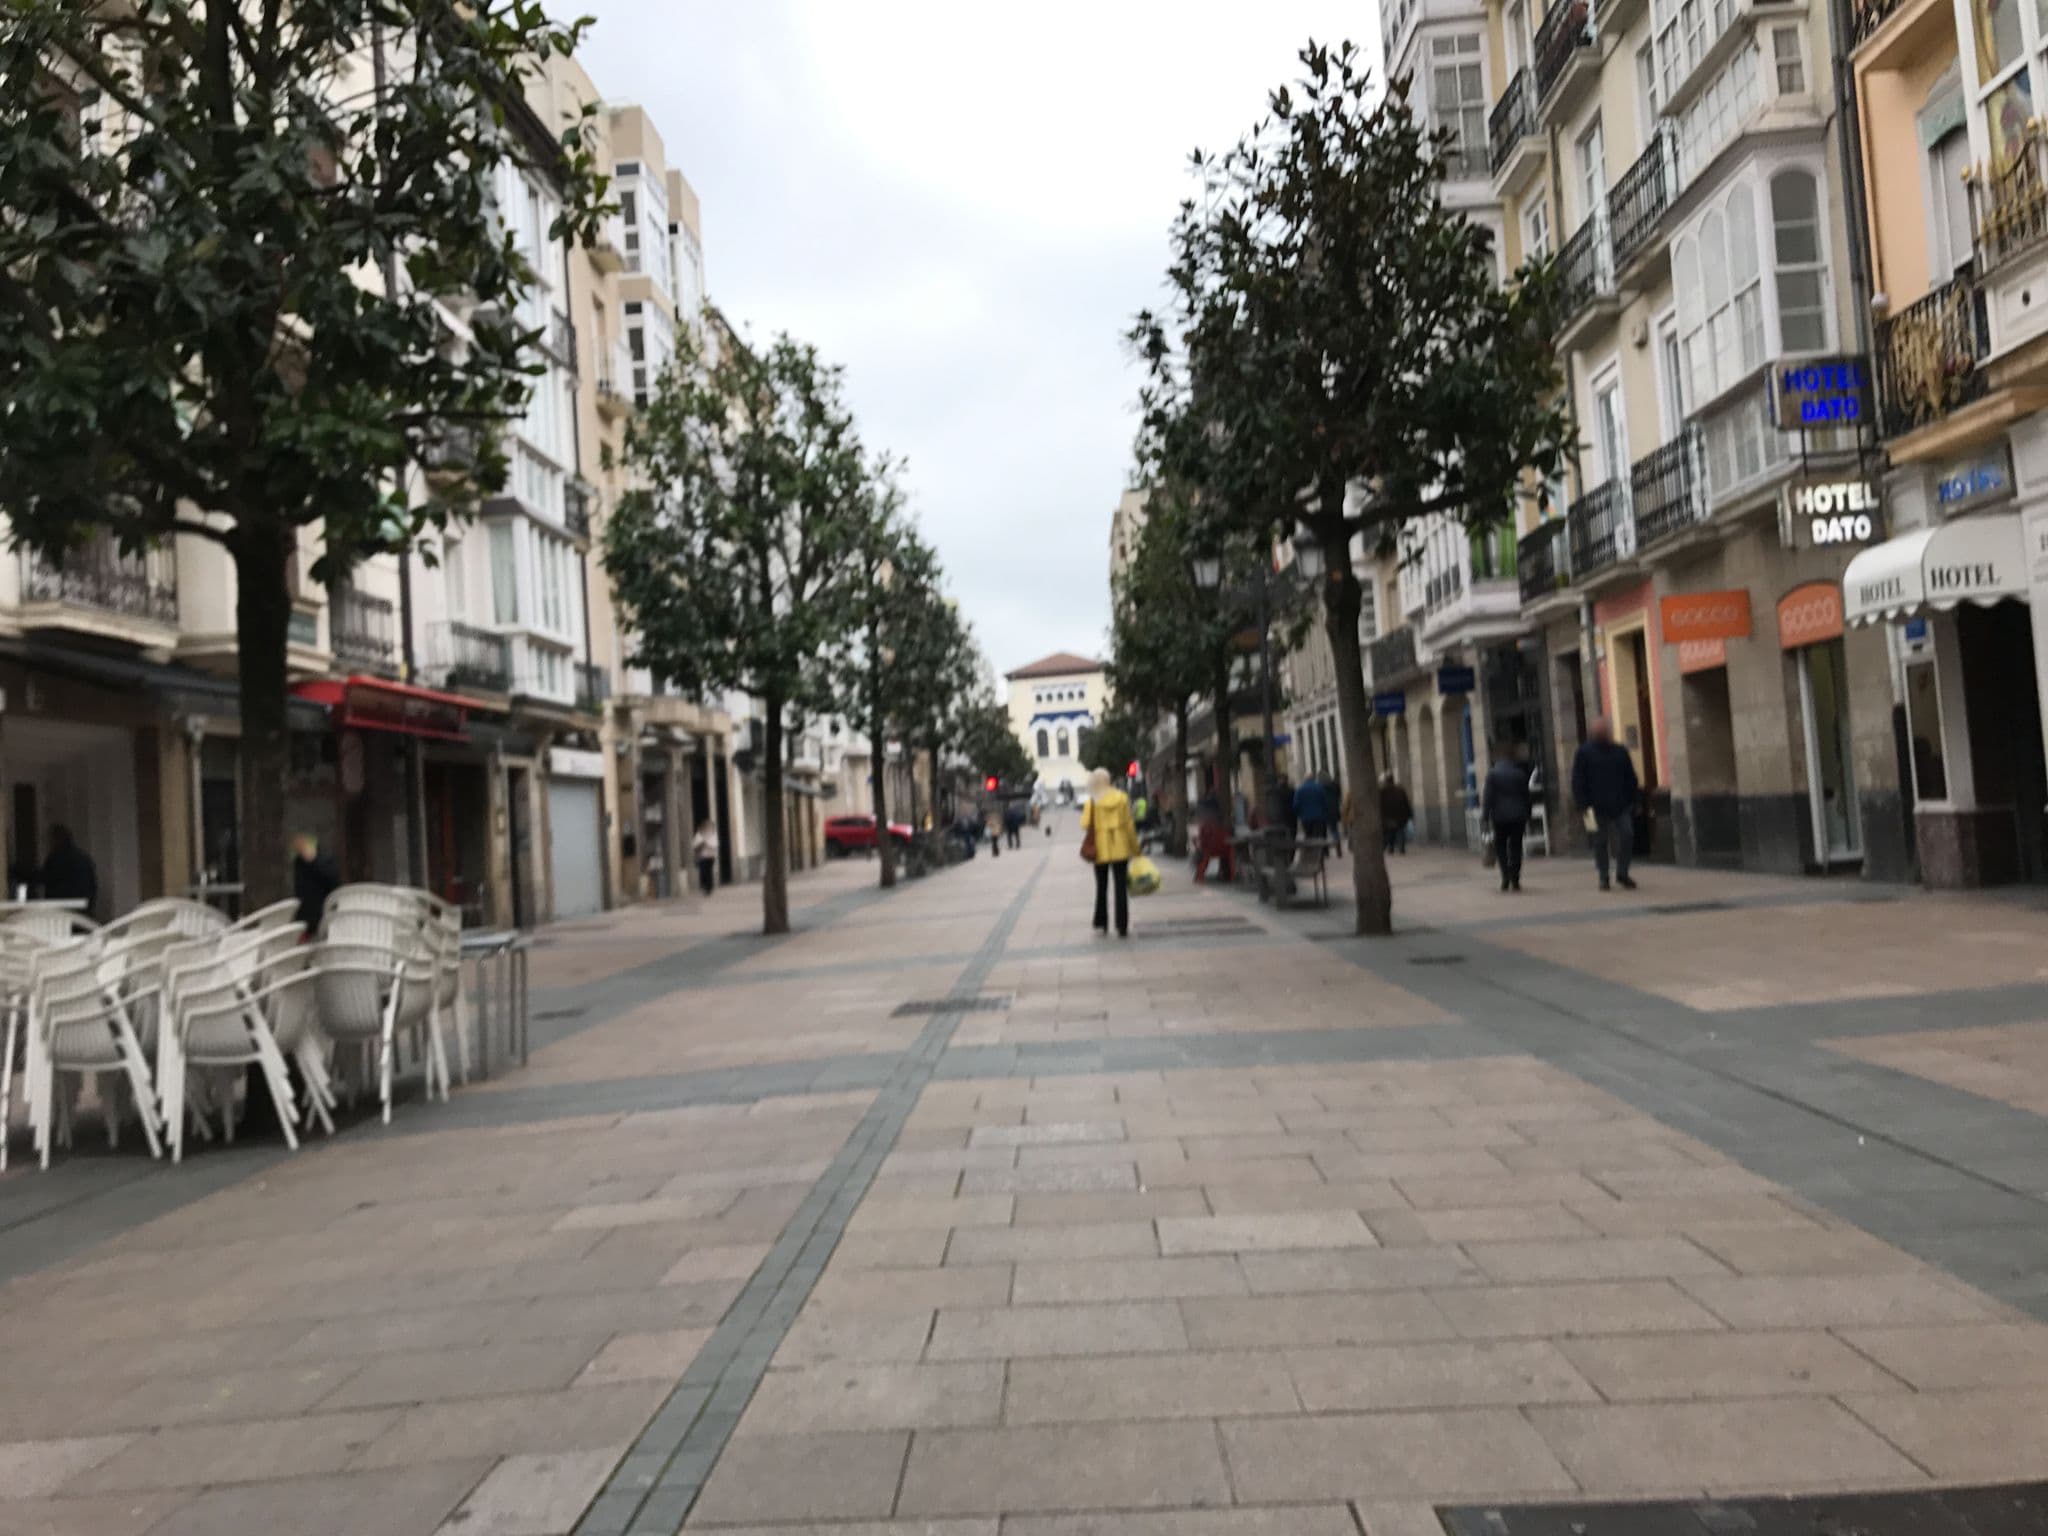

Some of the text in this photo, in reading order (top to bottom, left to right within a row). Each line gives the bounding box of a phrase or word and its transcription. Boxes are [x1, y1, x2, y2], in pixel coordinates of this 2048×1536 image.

[1784, 363, 1868, 394] HOTEL
[1801, 395, 1859, 423] DATO
[1796, 482, 1880, 514] HOTEL
[1812, 514, 1872, 544] DATO
[1861, 576, 1906, 606] HOTEL
[1931, 562, 2002, 591] HOTEL
